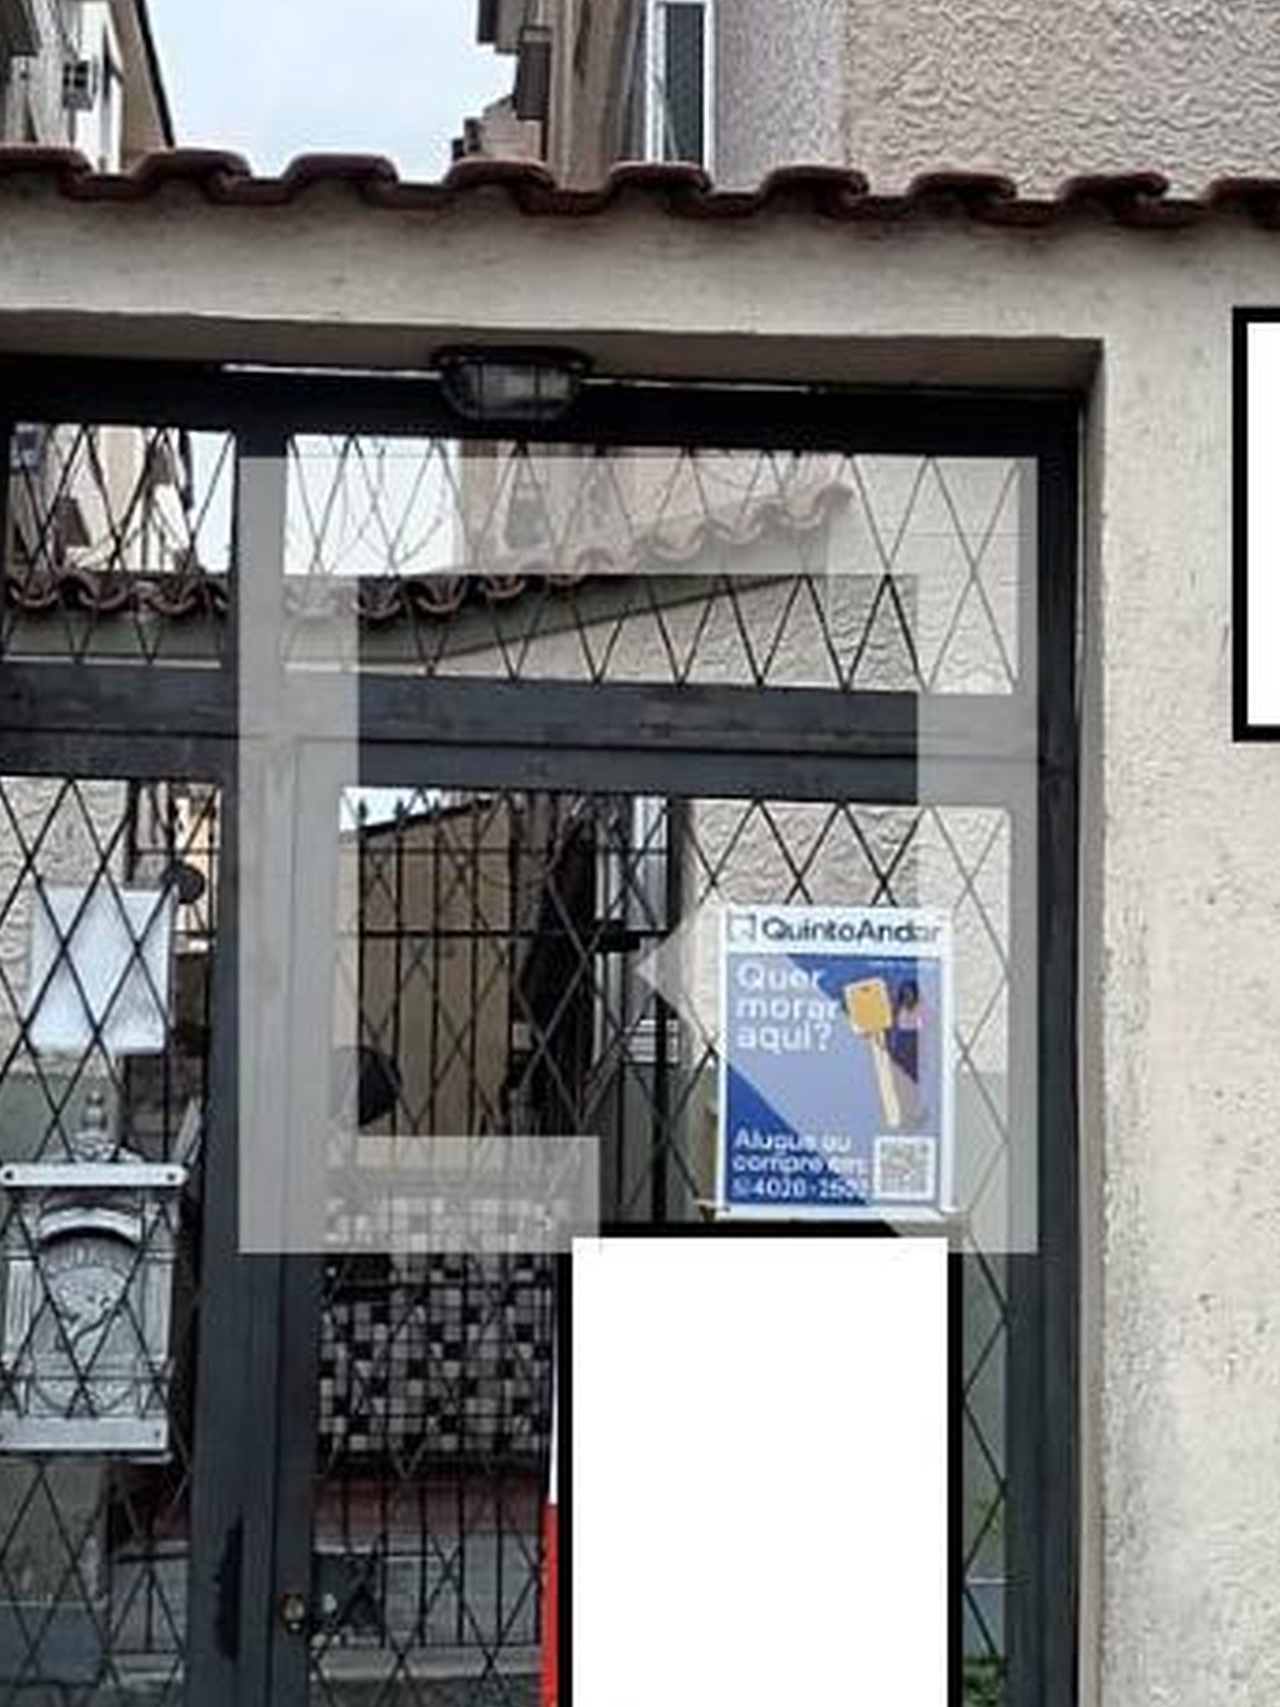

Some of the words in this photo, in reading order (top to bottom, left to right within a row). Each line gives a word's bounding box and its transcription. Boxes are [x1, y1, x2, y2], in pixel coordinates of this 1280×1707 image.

[762, 916, 941, 944] QuintoAndar
[736, 961, 826, 991] Quer
[736, 997, 839, 1020] morar
[736, 1021, 832, 1054] aqui?
[734, 1127, 817, 1156] Alugue
[732, 1155, 824, 1180] compre
